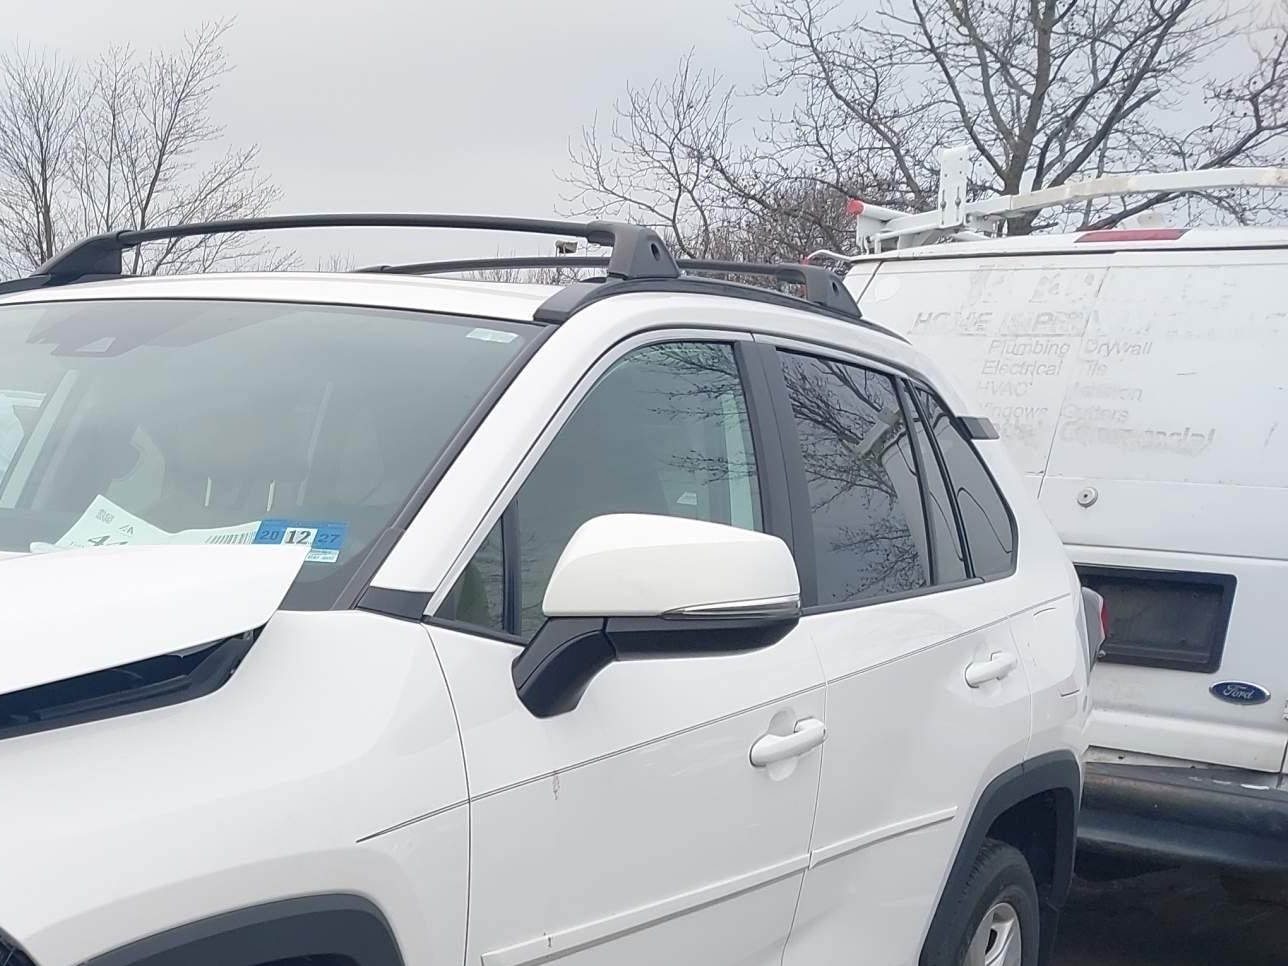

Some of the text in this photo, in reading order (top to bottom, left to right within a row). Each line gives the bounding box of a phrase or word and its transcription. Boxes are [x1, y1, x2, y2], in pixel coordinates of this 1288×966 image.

[988, 339, 1071, 358] Plumbing
[981, 359, 1063, 376] Electrical
[259, 529, 341, 545] 20 12 27
[1223, 684, 1255, 700] Ford
